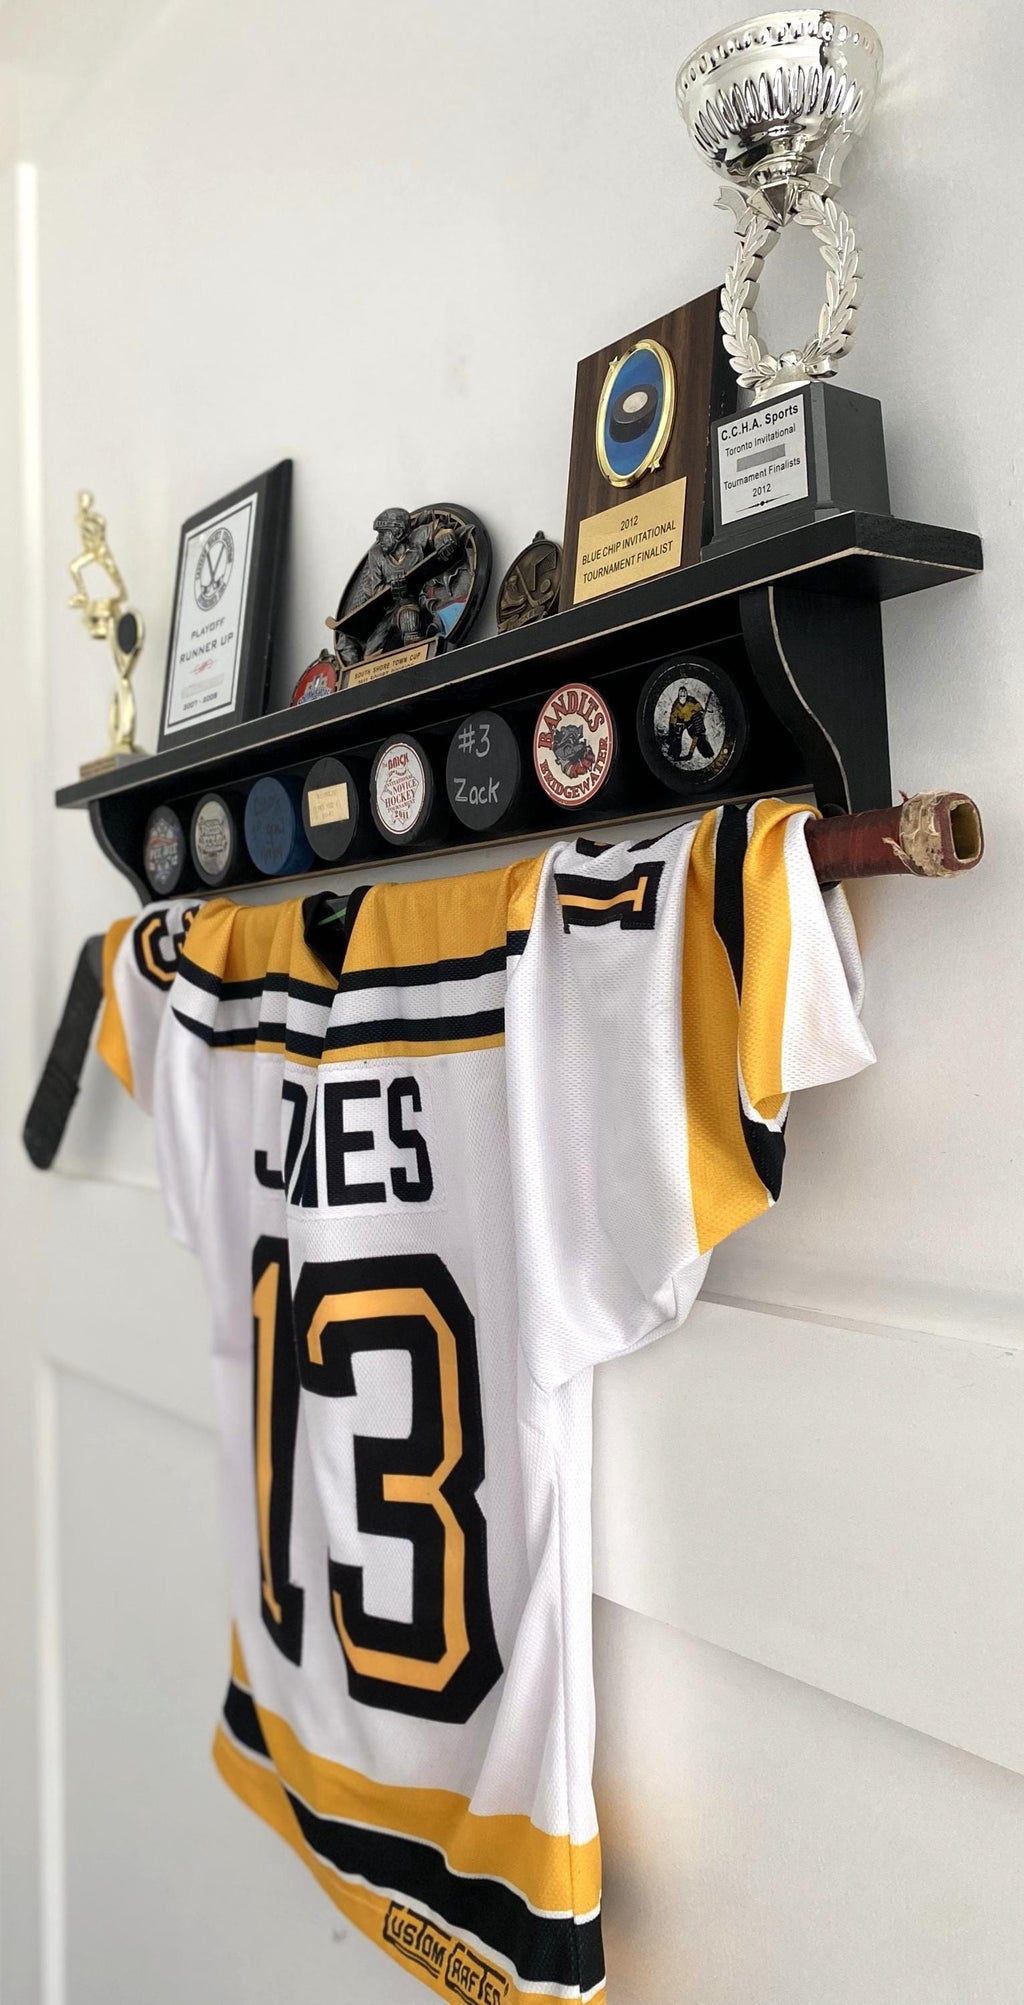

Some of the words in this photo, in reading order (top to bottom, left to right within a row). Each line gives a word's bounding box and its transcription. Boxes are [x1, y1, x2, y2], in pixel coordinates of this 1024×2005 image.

[721, 418, 762, 441] C.C.H.A.
[764, 404, 799, 425] Sports
[725, 440, 753, 457] Toronto
[754, 423, 796, 447] Invitational
[723, 469, 767, 496] Tournament
[768, 457, 801, 475] Finalists
[752, 483, 771, 497] 2012
[620, 515, 638, 531] 2012
[582, 549, 602, 566] BLUE
[602, 541, 622, 558] CHIP
[622, 520, 677, 550] INVITATIONAL
[583, 554, 636, 584] TOURNAMENT
[637, 540, 674, 563] FINALIST
[191, 616, 225, 641] PLAYOFF
[179, 639, 218, 665] RUNNER
[220, 632, 234, 647] UP
[354, 669, 371, 680] SOUTH
[372, 662, 390, 674] SHORE
[392, 657, 408, 667] TOWN
[409, 652, 422, 662] CUP
[537, 690, 606, 751] BANDITS
[458, 723, 490, 758] #3
[387, 753, 409, 770] BRICK
[539, 736, 609, 799] BRIDGEWATER
[385, 789, 416, 808] HOCKEY
[393, 779, 417, 794] NOVICE
[453, 777, 500, 805] Zack
[252, 1234, 504, 1725] 13
[383, 1900, 451, 1979] CUSTOM
